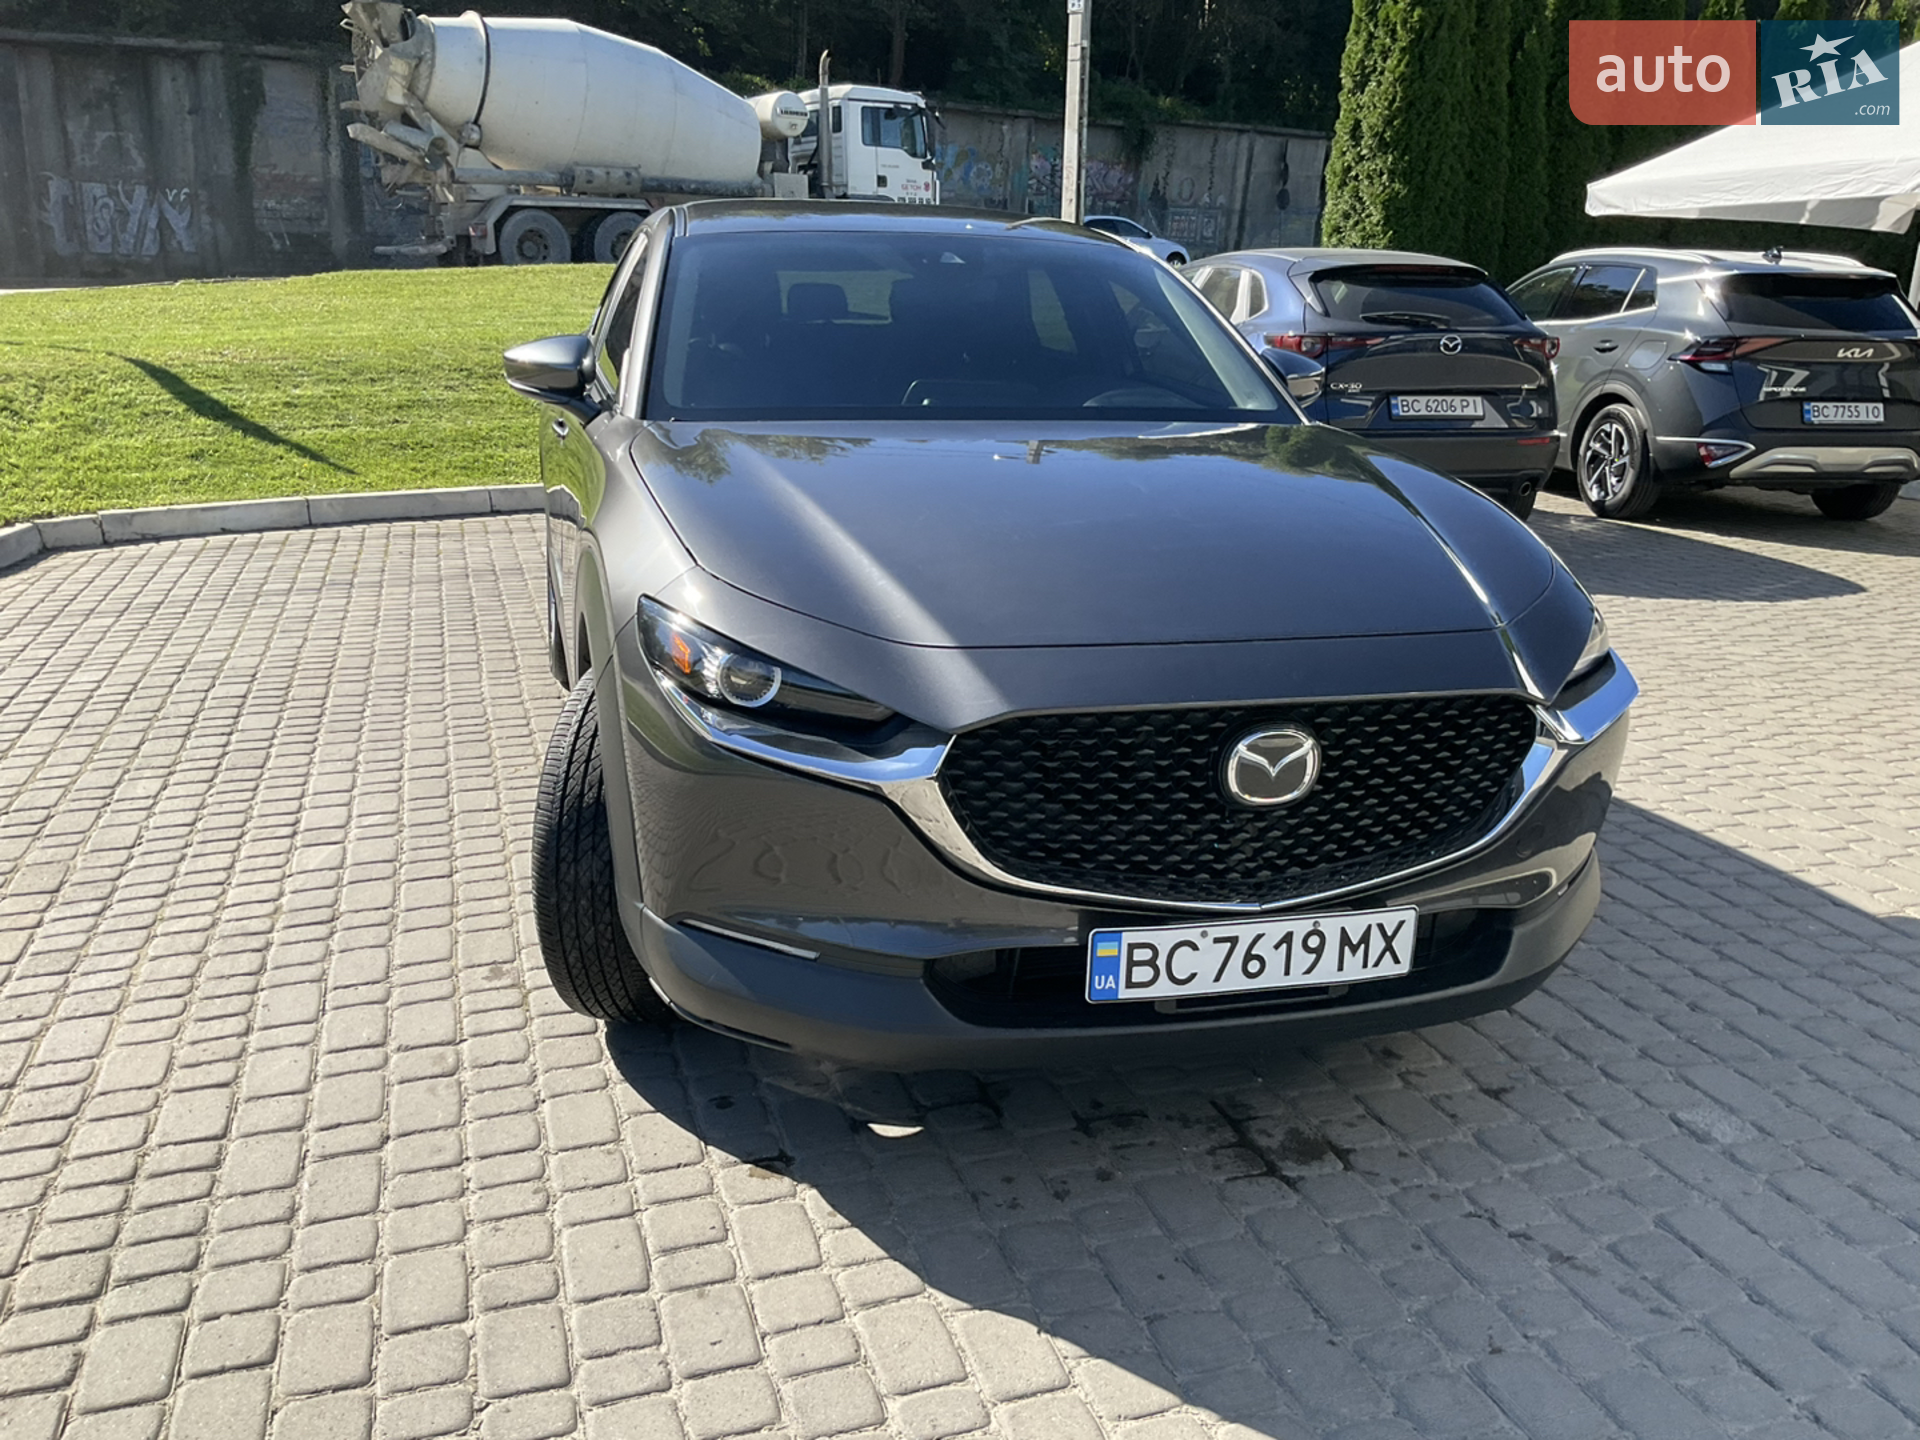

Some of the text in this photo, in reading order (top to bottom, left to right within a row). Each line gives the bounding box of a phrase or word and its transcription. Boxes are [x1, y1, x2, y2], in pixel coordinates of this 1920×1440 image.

[1837, 347, 1874, 358] KIA
[1330, 382, 1363, 390] CX-30
[1400, 399, 1422, 414] BC
[1425, 399, 1457, 413] 6206
[1811, 405, 1830, 418] BC
[1833, 405, 1860, 418] 7755
[1124, 919, 1407, 990] BC 7619 MX
[1094, 974, 1117, 990] UA
